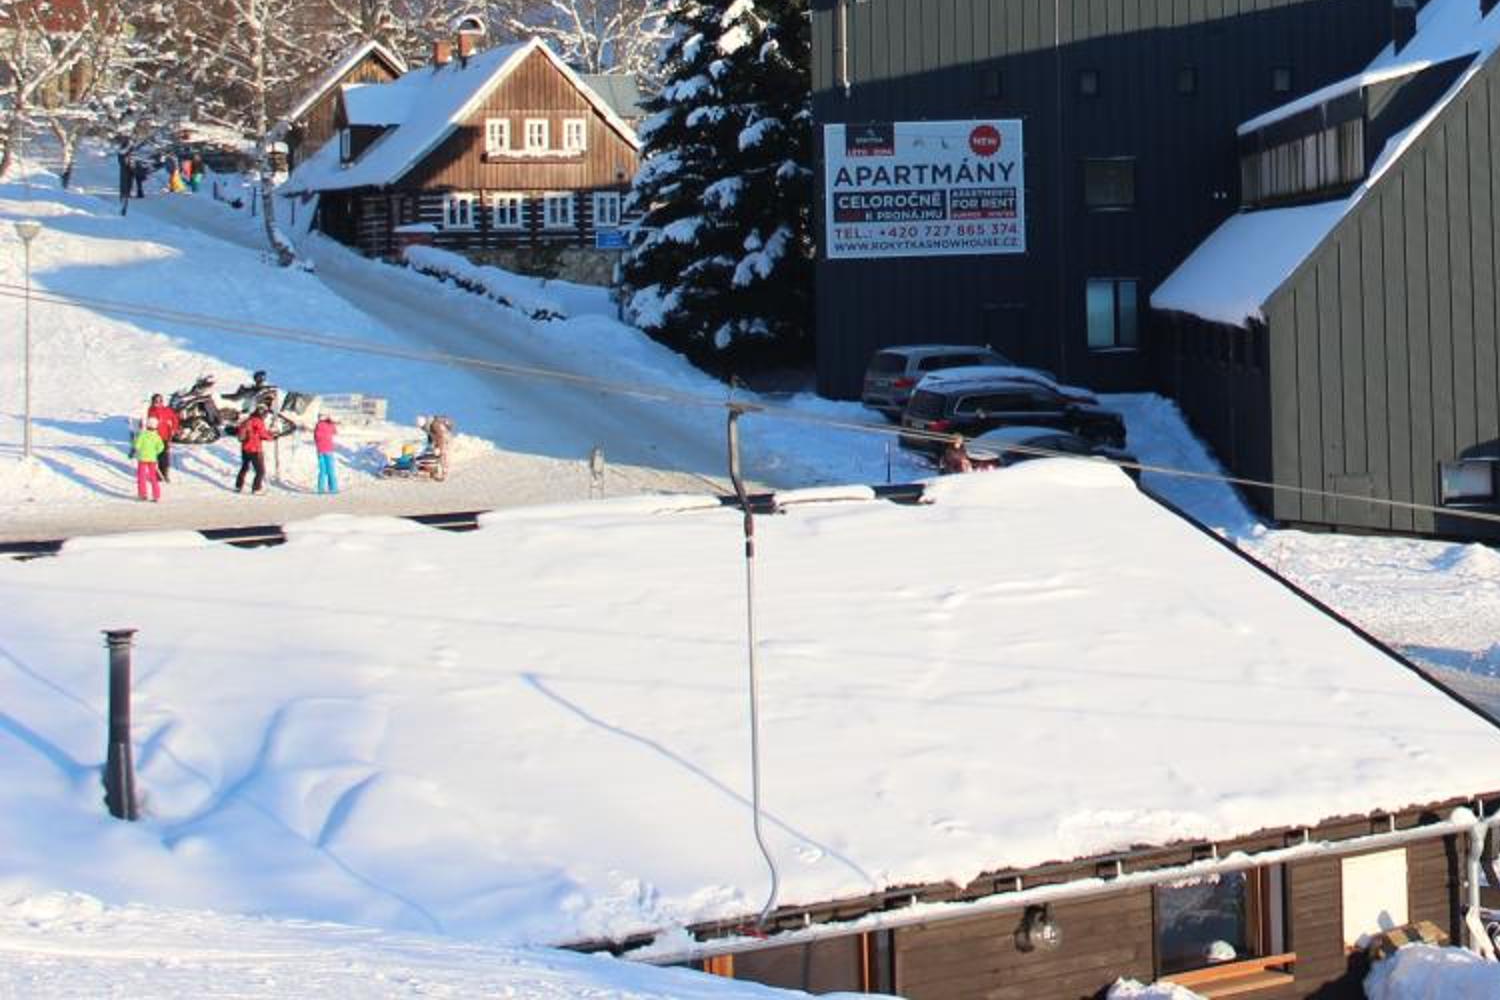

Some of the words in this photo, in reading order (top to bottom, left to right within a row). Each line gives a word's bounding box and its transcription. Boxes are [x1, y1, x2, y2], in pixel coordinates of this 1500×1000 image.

[834, 158, 1015, 187] APARTMÁNY
[952, 199, 977, 209] FOR
[981, 197, 1015, 209] RENT
[924, 225, 951, 237] 727
